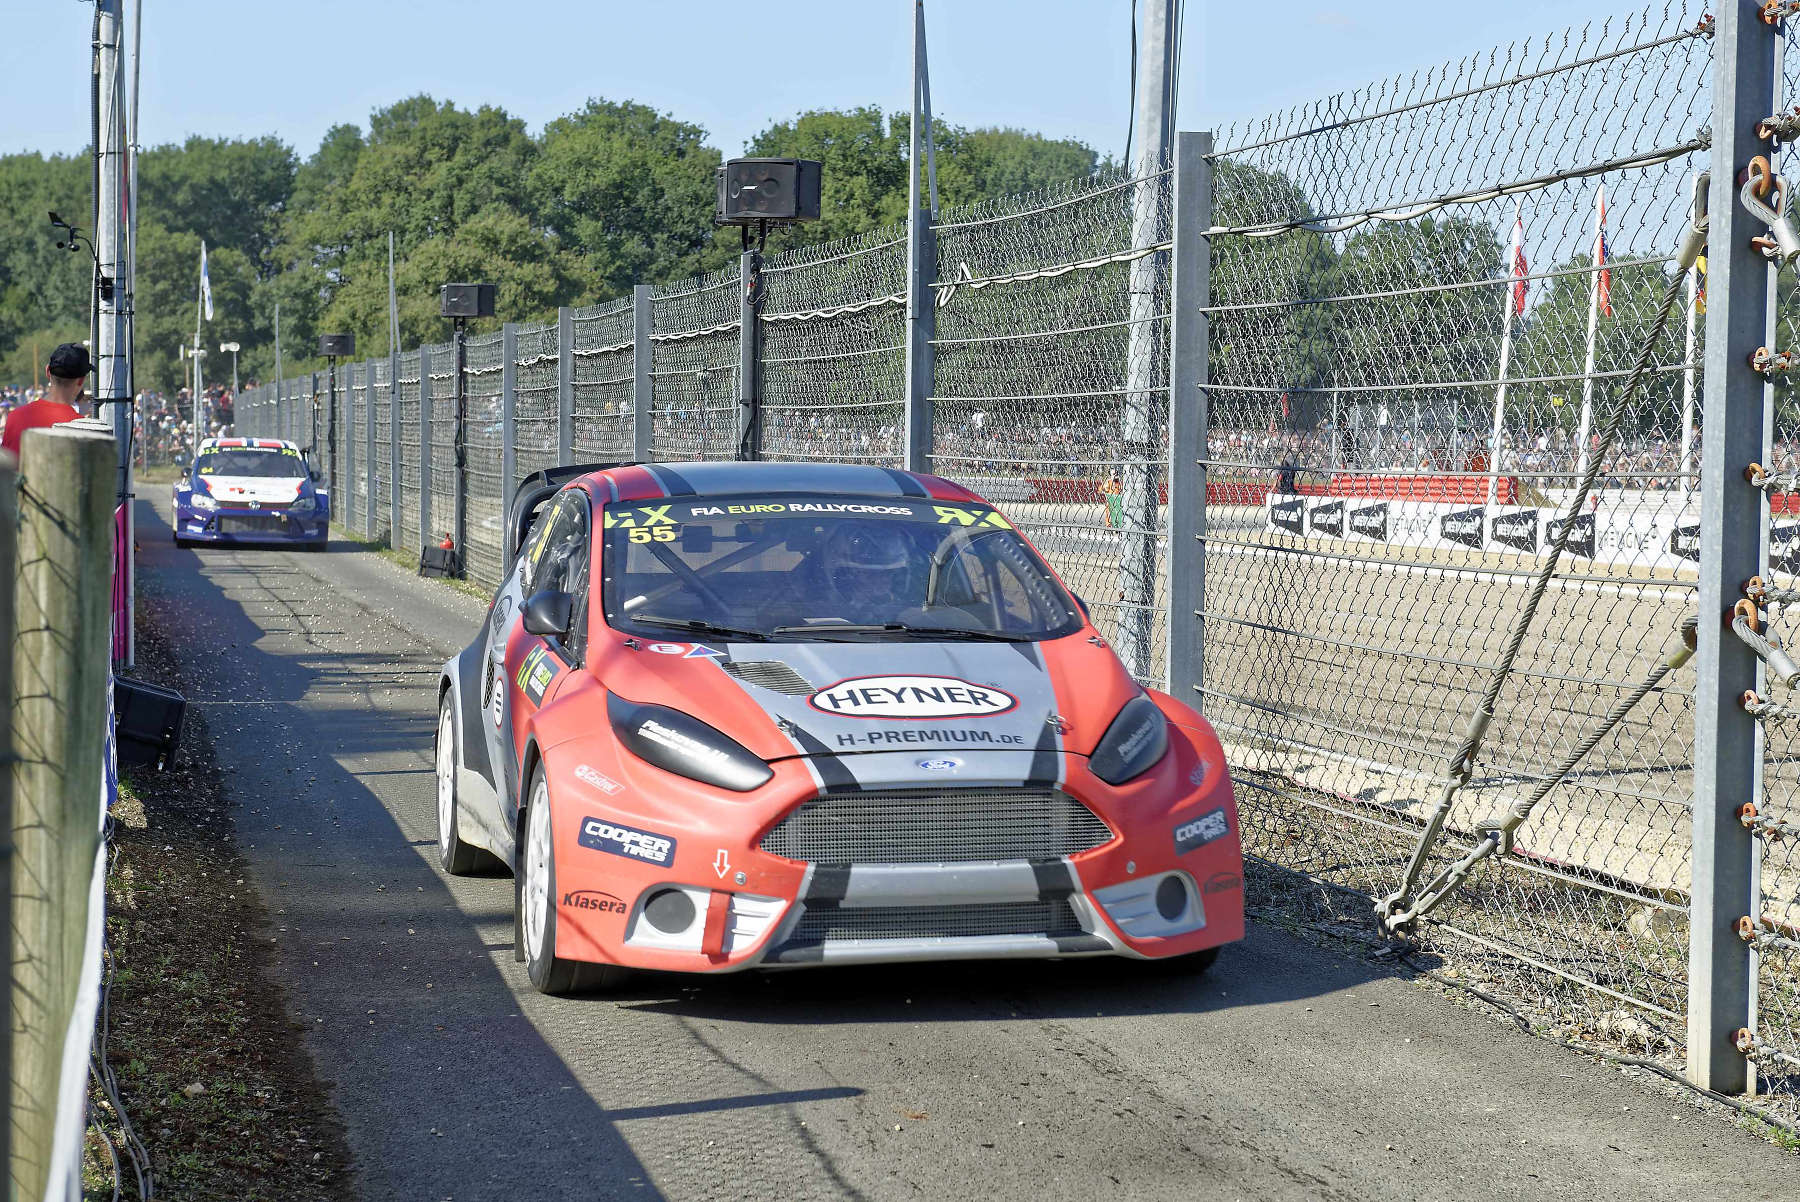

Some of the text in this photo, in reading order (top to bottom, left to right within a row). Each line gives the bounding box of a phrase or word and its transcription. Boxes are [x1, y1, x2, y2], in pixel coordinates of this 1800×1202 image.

[691, 503, 913, 517] FIA EURO RALLYCROSS
[629, 525, 676, 544] 55
[827, 686, 1000, 709] HEYNER
[836, 729, 1025, 747] H-PREMIUM.DE
[1176, 810, 1226, 842] COOPER
[585, 821, 672, 853] COOPER
[622, 842, 667, 862] TIRES
[563, 892, 627, 914] Klasera
